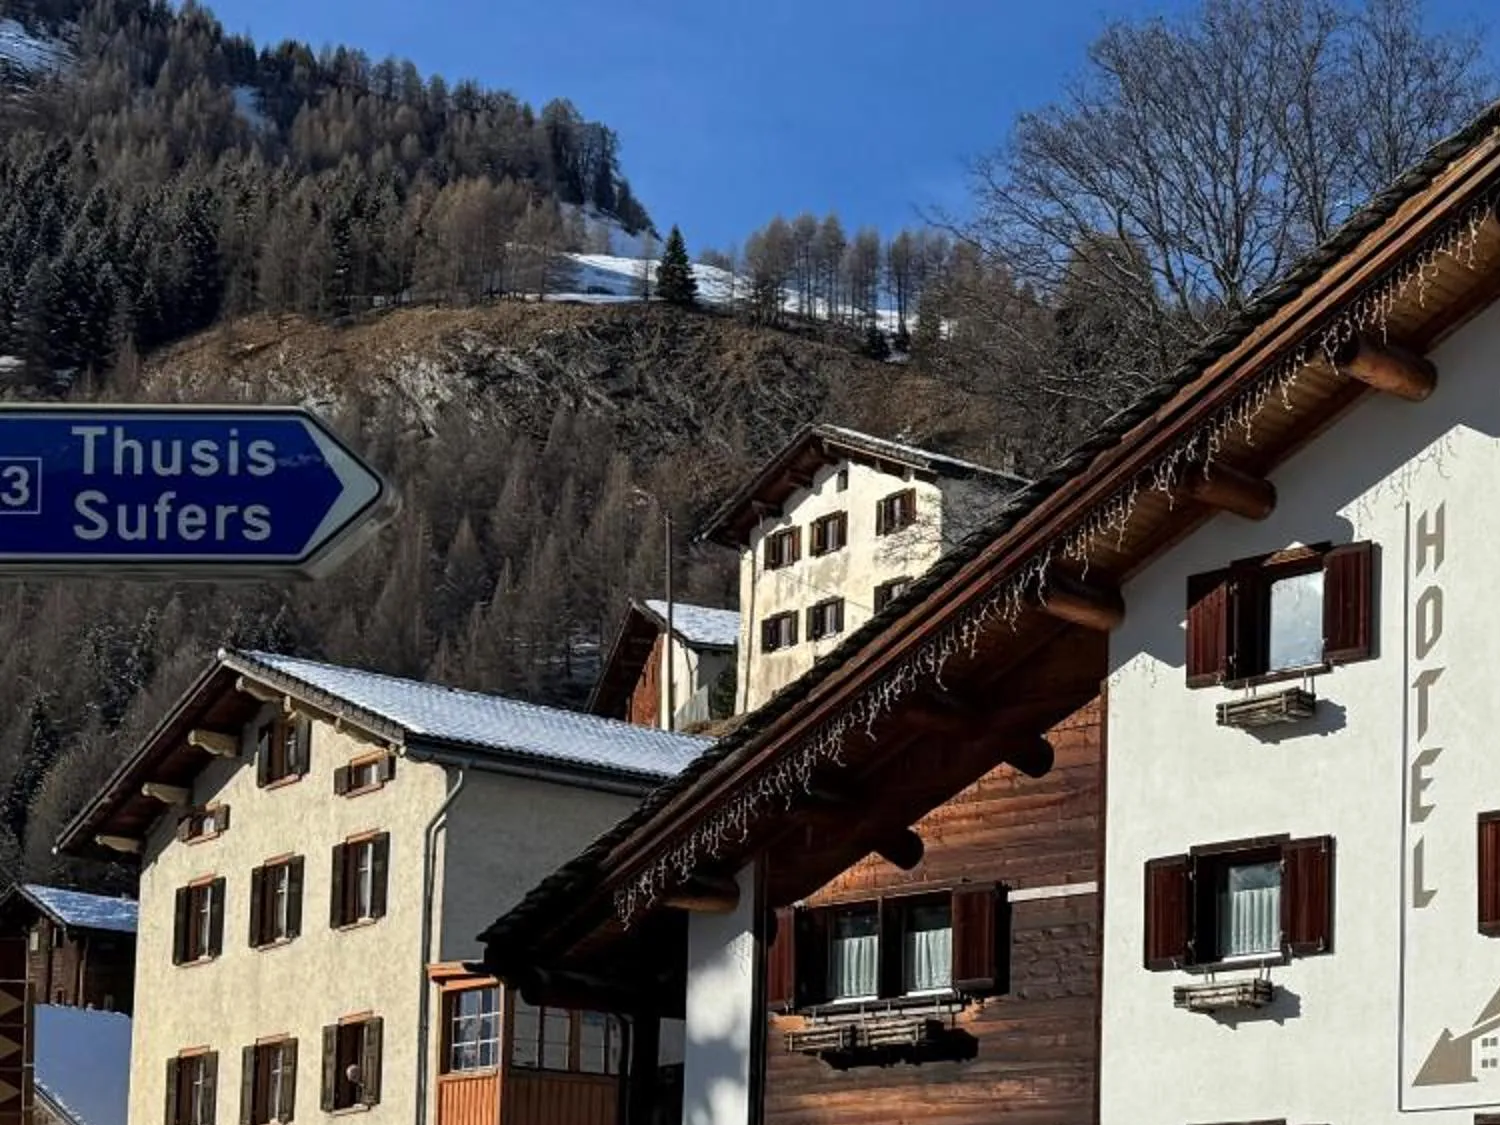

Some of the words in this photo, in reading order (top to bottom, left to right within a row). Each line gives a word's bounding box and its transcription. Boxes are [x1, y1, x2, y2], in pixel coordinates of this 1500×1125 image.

[72, 425, 276, 476] Thusis
[73, 490, 272, 541] Sufers
[1410, 501, 1446, 910] HOTEL
